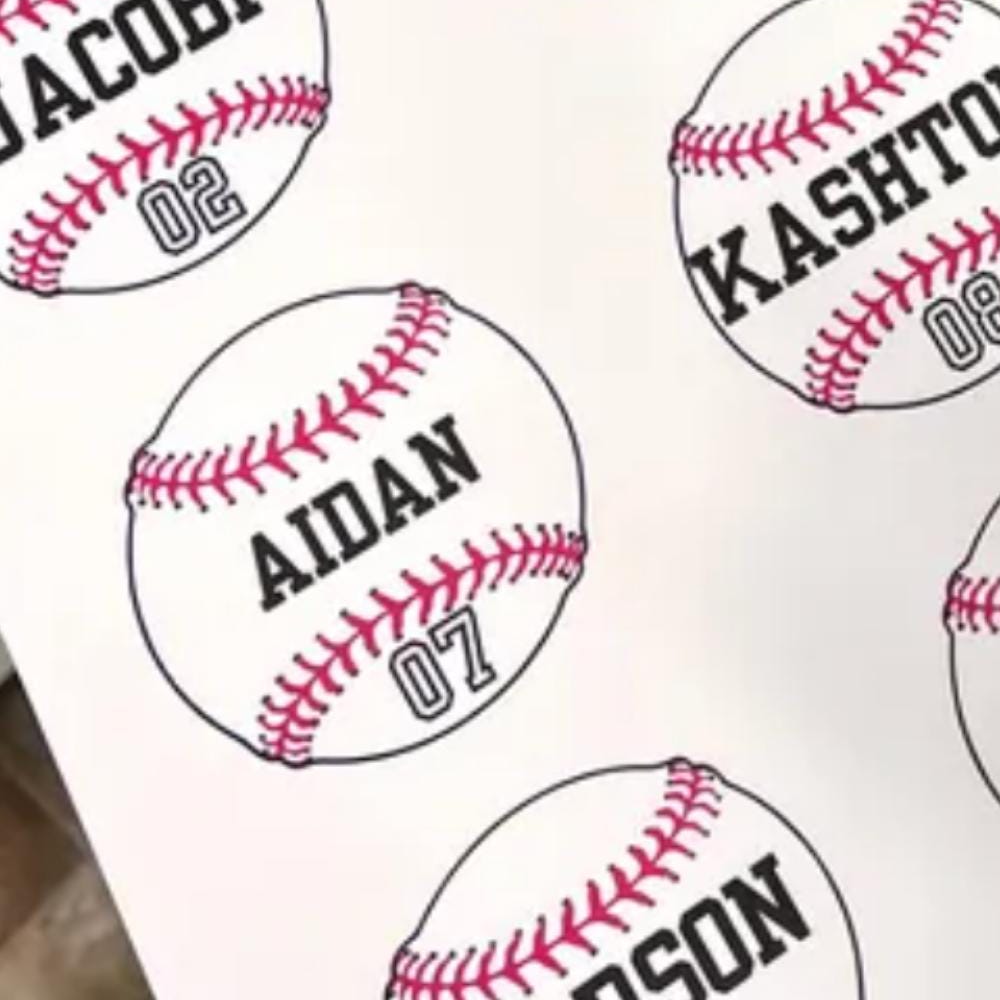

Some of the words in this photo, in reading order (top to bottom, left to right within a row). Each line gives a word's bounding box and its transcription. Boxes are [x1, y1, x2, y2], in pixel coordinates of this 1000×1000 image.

[136, 155, 248, 257] 02
[250, 415, 481, 612] AIDAN
[388, 603, 498, 722] 07
